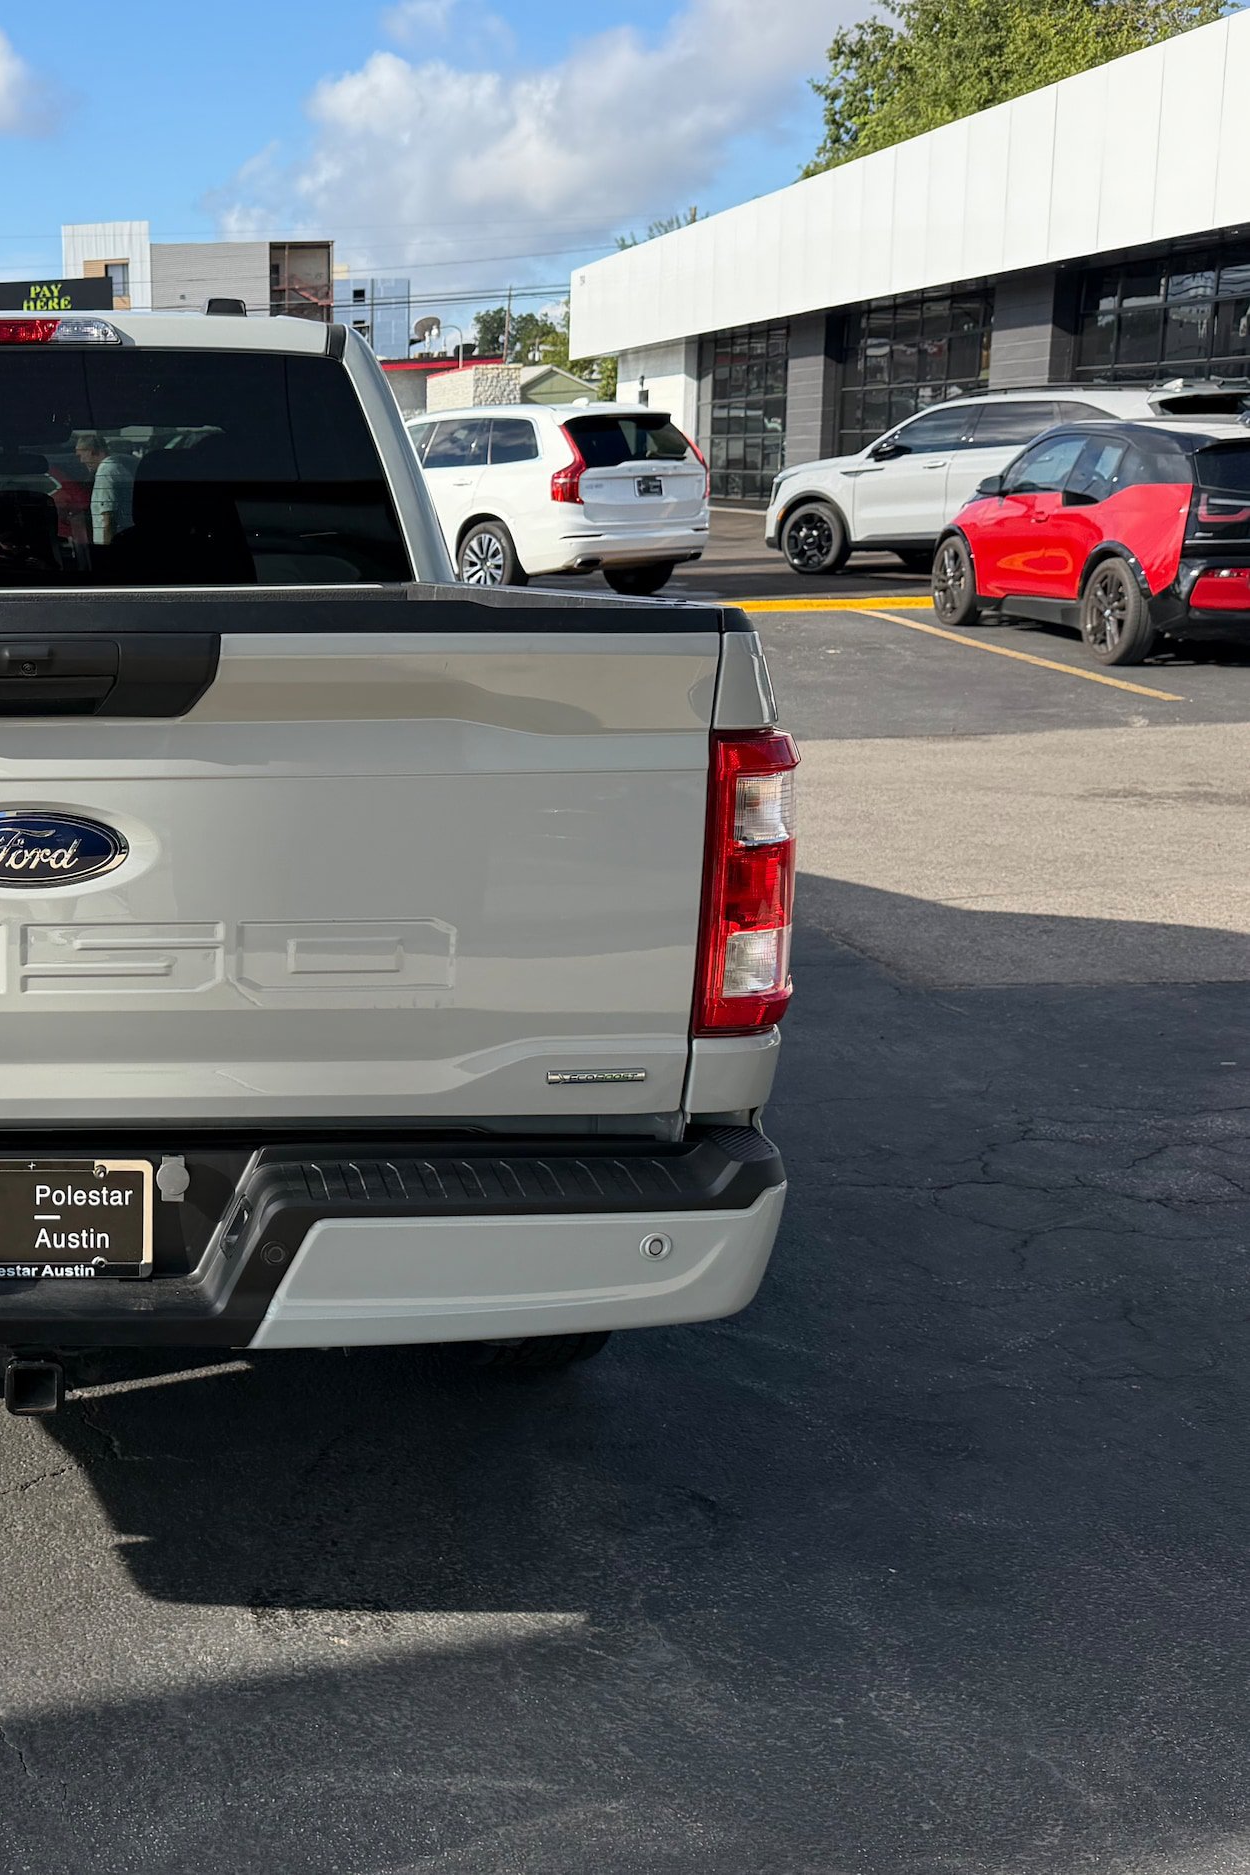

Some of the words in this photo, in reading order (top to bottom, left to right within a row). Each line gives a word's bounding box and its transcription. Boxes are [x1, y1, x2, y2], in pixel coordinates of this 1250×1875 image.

[30, 283, 62, 298] PAY
[23, 296, 72, 311] HERE
[34, 1184, 134, 1206] Polestar
[34, 1227, 111, 1250] Austin
[41, 1265, 96, 1278] Austin
